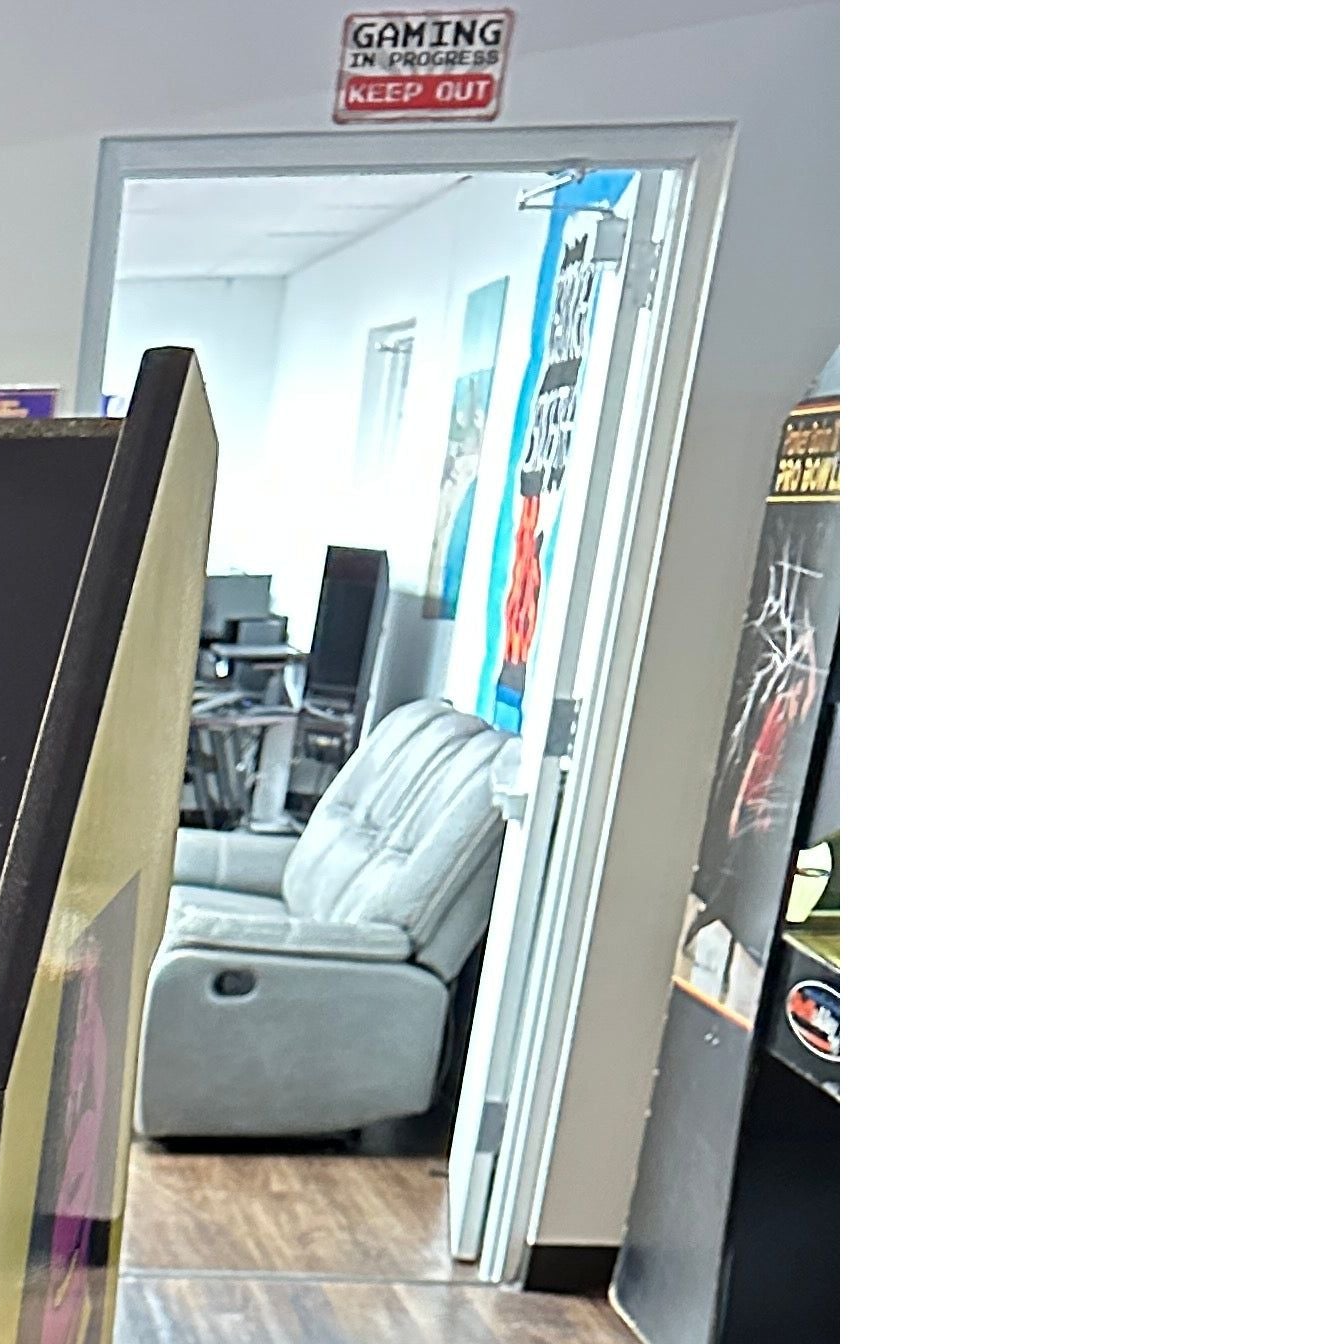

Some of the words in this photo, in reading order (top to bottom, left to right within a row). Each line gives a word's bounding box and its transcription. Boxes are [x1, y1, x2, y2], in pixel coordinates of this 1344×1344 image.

[352, 19, 504, 49] GAMING
[350, 52, 377, 68] IN
[388, 49, 500, 67] PROGRESS
[347, 80, 424, 105] KEEP
[435, 80, 492, 101] OUT
